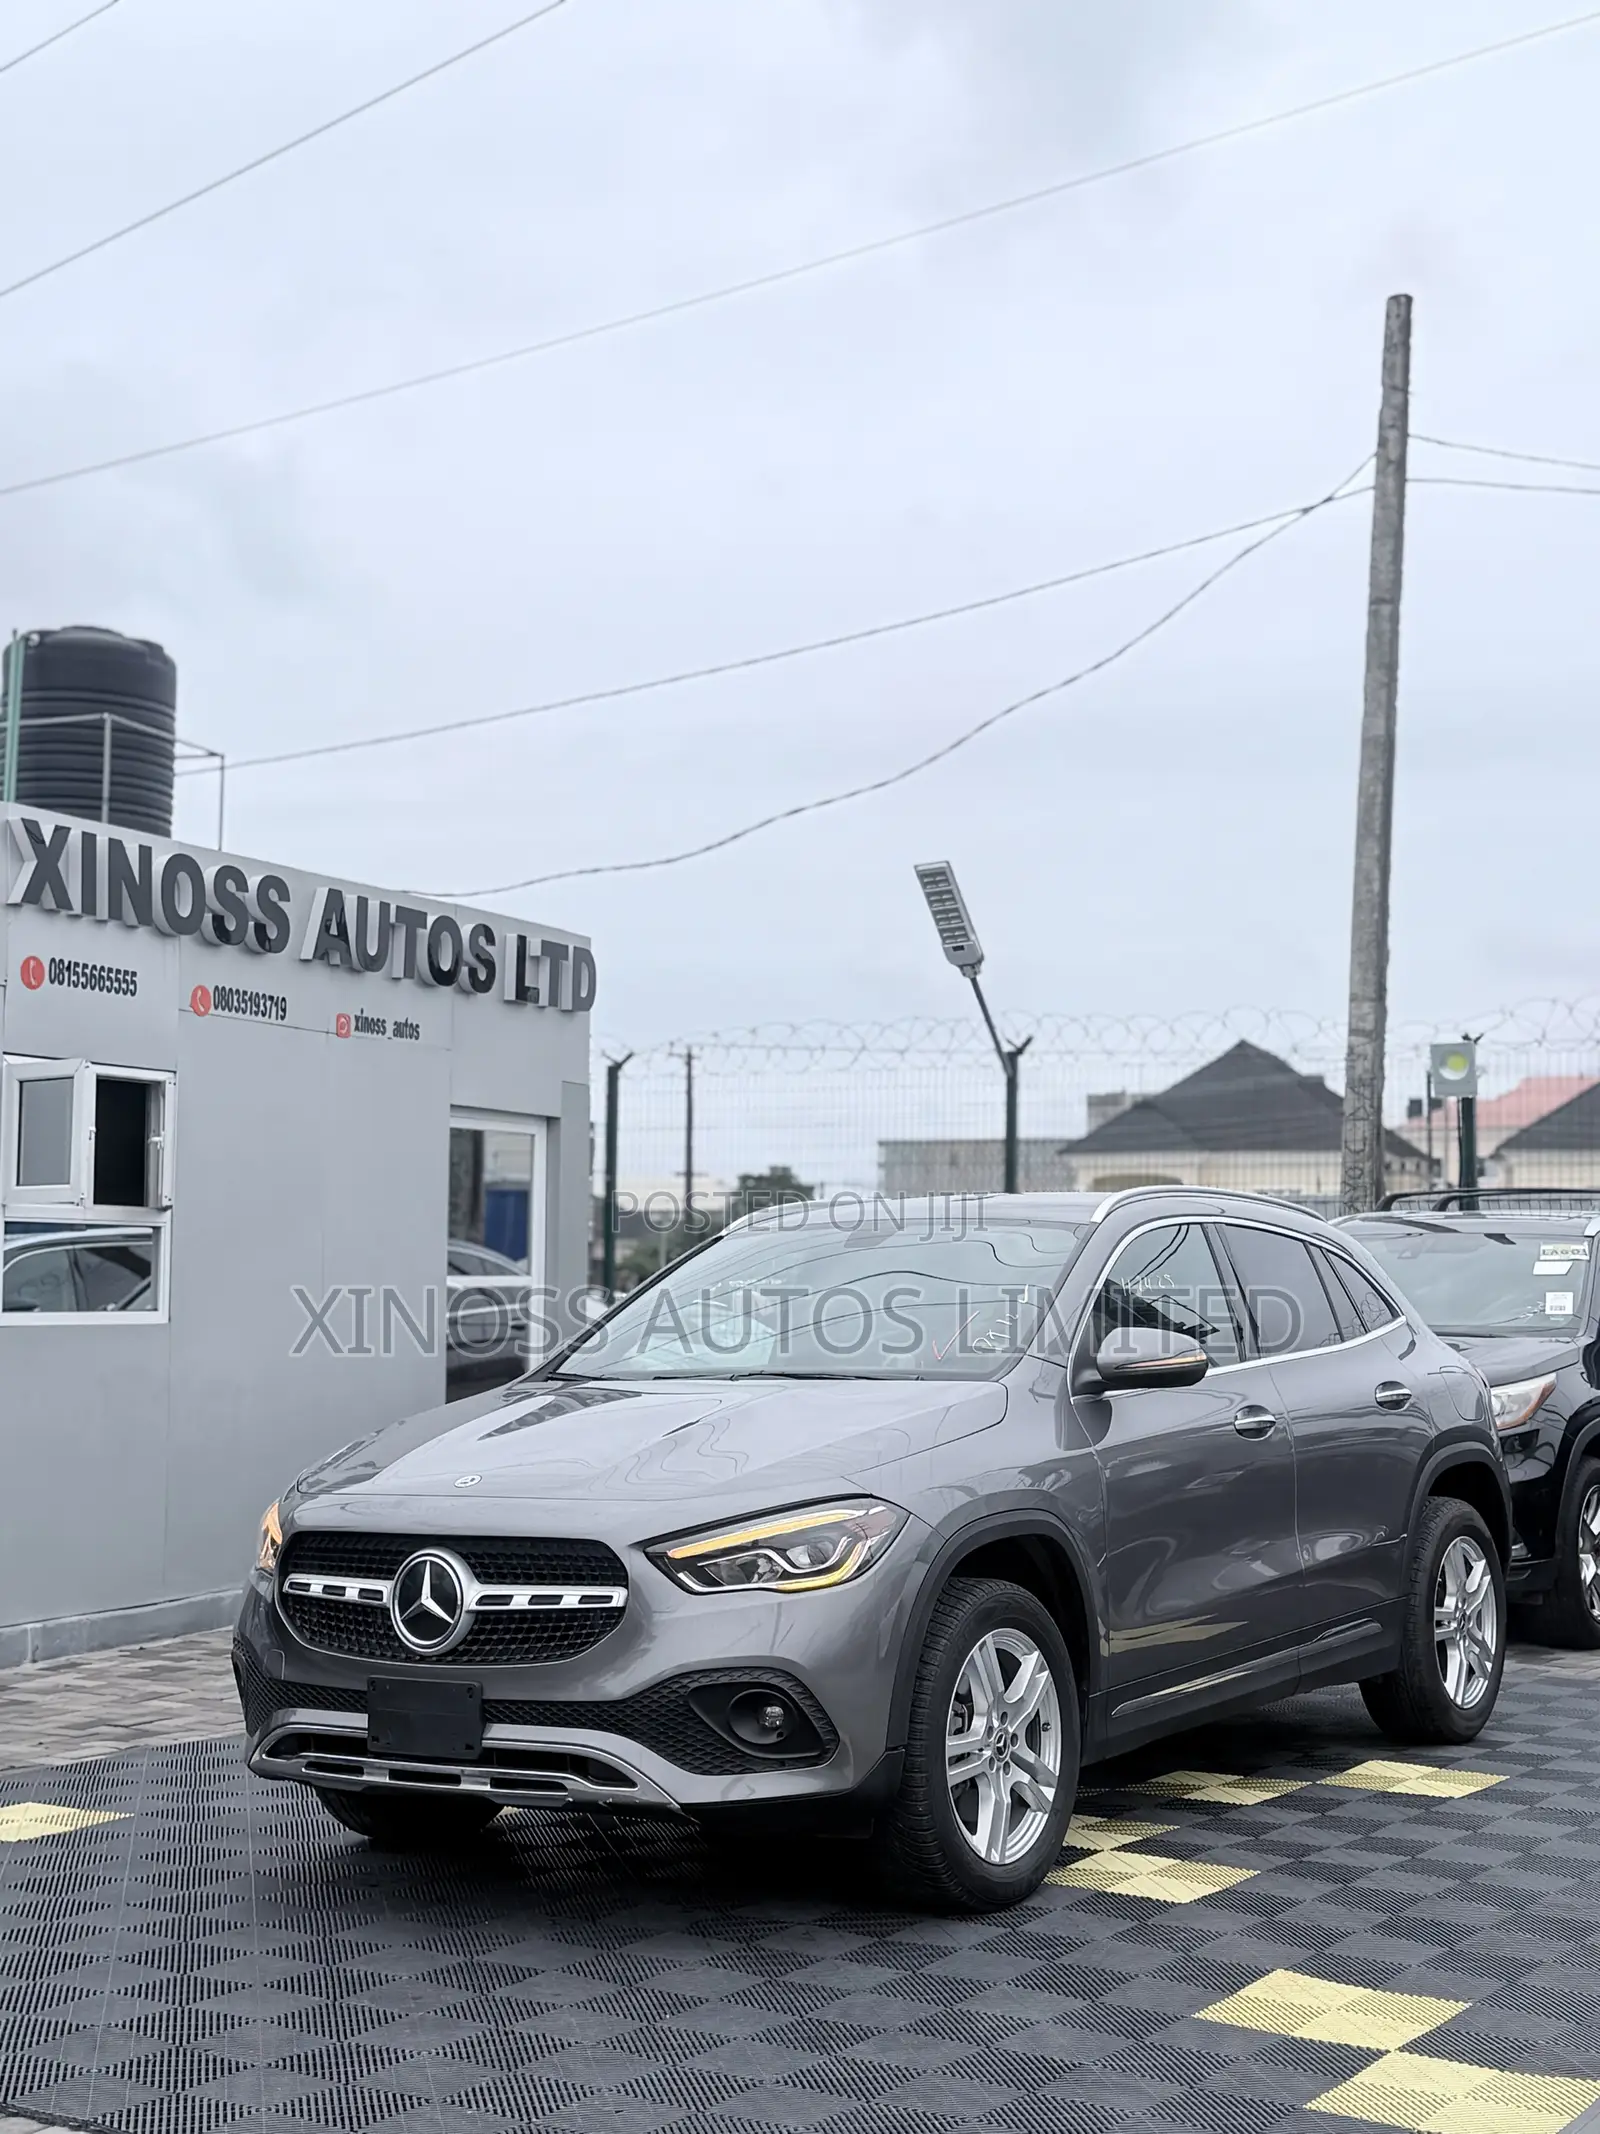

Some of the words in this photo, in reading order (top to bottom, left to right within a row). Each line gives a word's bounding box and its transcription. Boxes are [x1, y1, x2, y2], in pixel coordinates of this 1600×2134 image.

[9, 817, 291, 954] XINOSS
[300, 887, 497, 994] AUTOS
[504, 933, 597, 1012] LTD
[48, 957, 138, 997] 08155665555
[213, 985, 287, 1021] 08035193719
